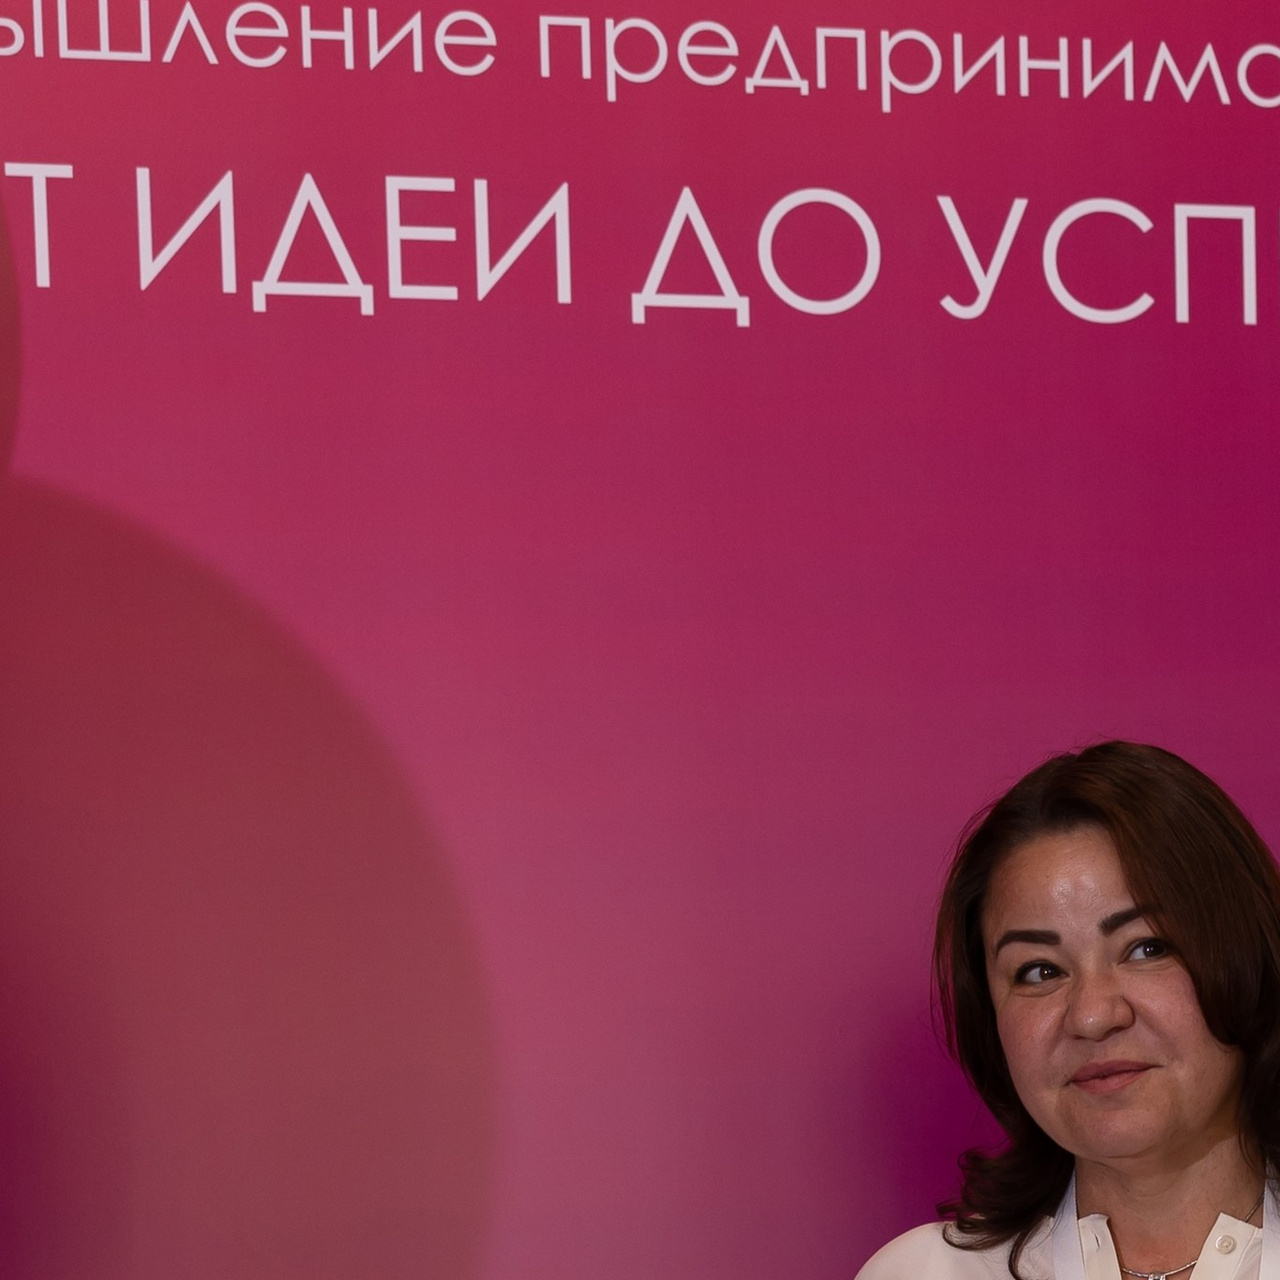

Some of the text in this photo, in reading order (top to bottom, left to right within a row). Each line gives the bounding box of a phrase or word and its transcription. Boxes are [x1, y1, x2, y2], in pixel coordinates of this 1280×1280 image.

[4, 161, 74, 288] Т
[135, 166, 572, 316] ИДЕИ
[631, 186, 881, 328] ДО
